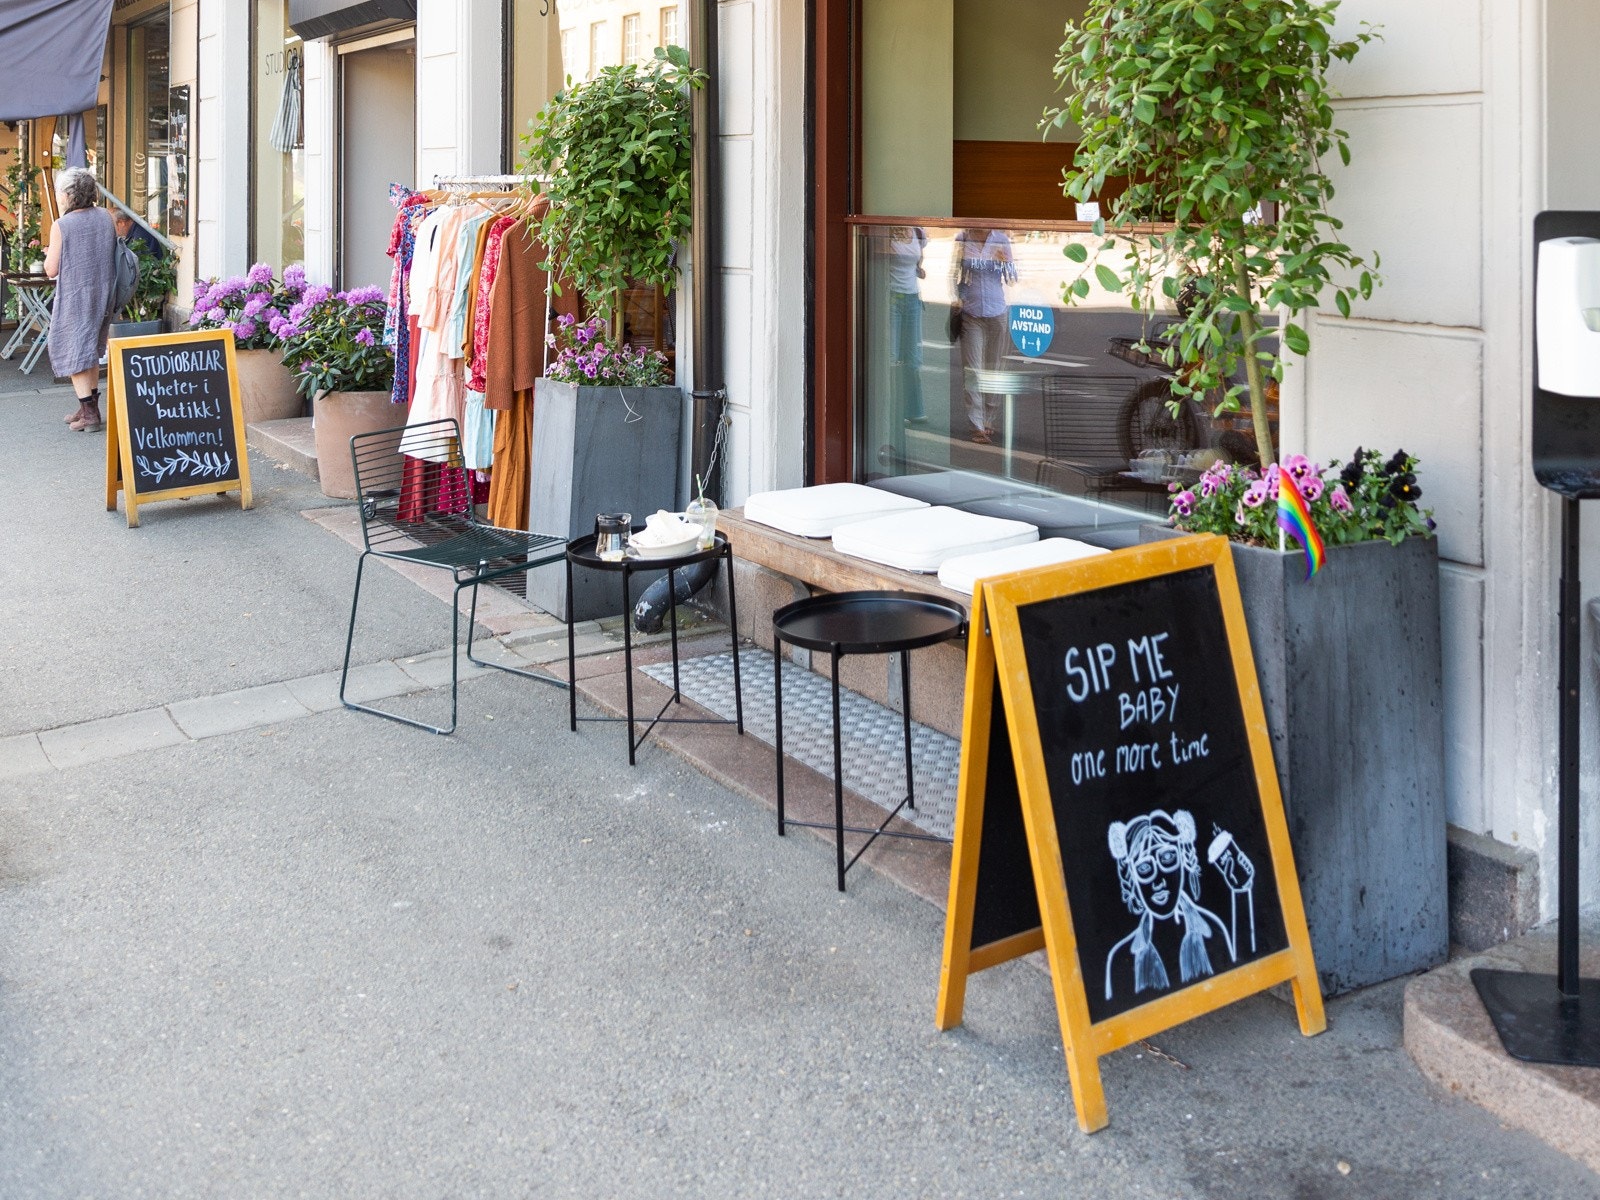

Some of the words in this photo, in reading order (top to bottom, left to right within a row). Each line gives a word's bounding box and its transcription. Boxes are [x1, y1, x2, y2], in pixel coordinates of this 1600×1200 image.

[1011, 319, 1051, 334] AVSTAND
[1019, 307, 1043, 320] HOLD
[136, 379, 199, 406] Nyheter
[203, 378, 210, 395] i
[134, 425, 223, 451] Velkommen!
[1064, 641, 1117, 703] SIP
[1127, 631, 1174, 684] ME
[1118, 682, 1181, 731] BABY
[1070, 747, 1106, 786] one
[1115, 741, 1163, 774] more
[1170, 731, 1211, 765] time
